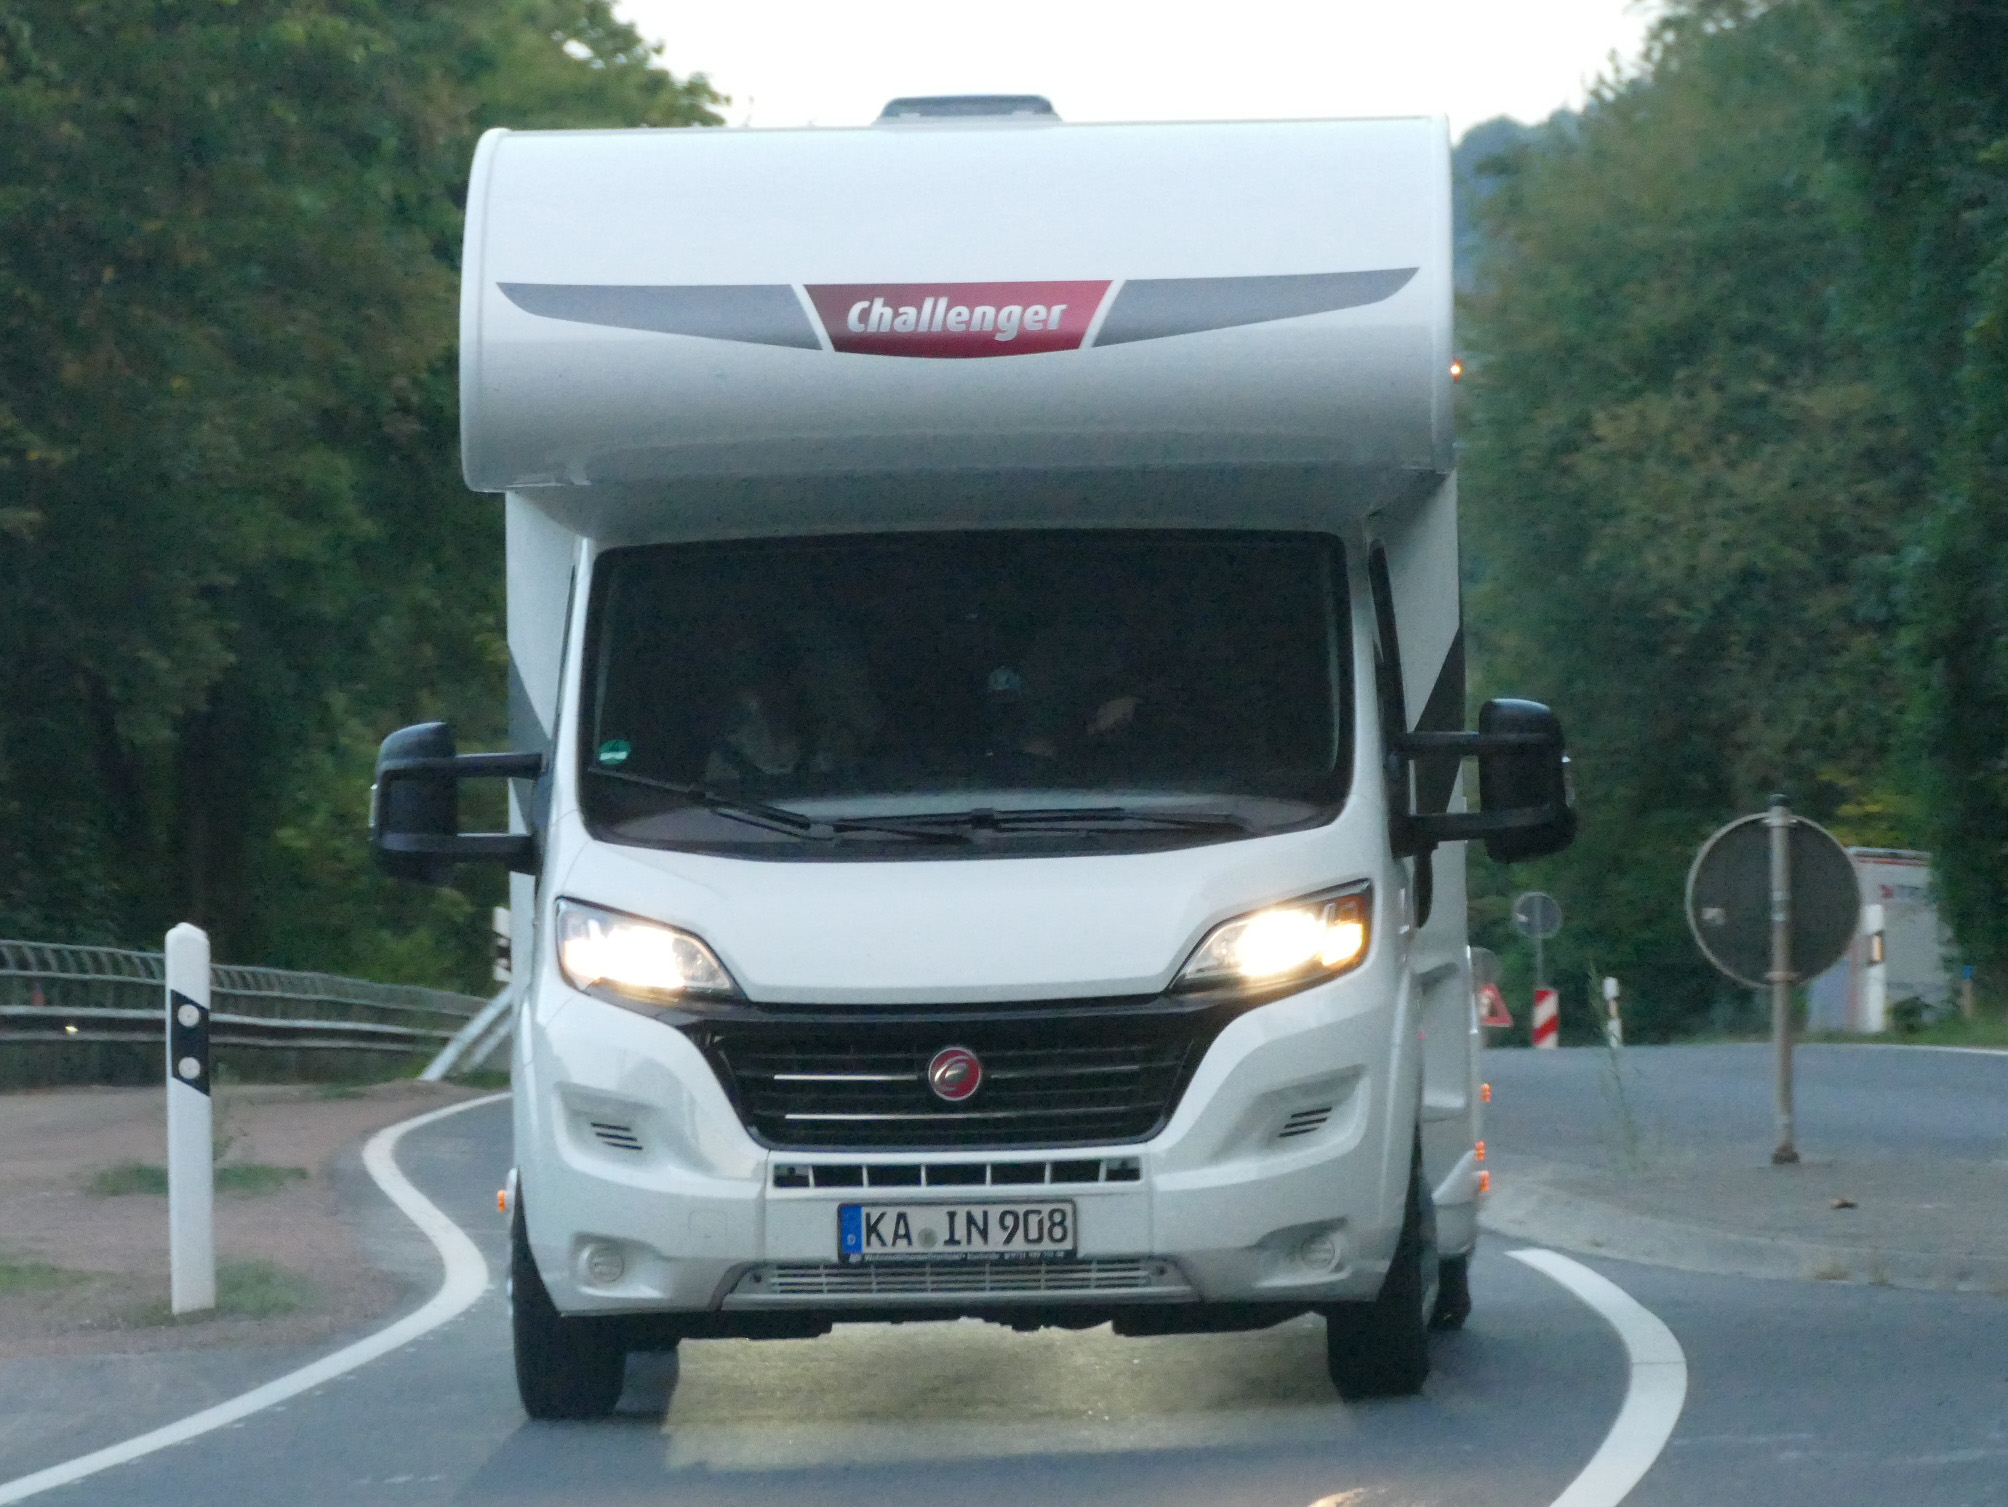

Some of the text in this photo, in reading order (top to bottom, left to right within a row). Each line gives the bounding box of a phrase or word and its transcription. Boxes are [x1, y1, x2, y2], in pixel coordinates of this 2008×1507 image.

[847, 297, 1068, 342] Challenger
[865, 1208, 1068, 1247] KA IN 908
